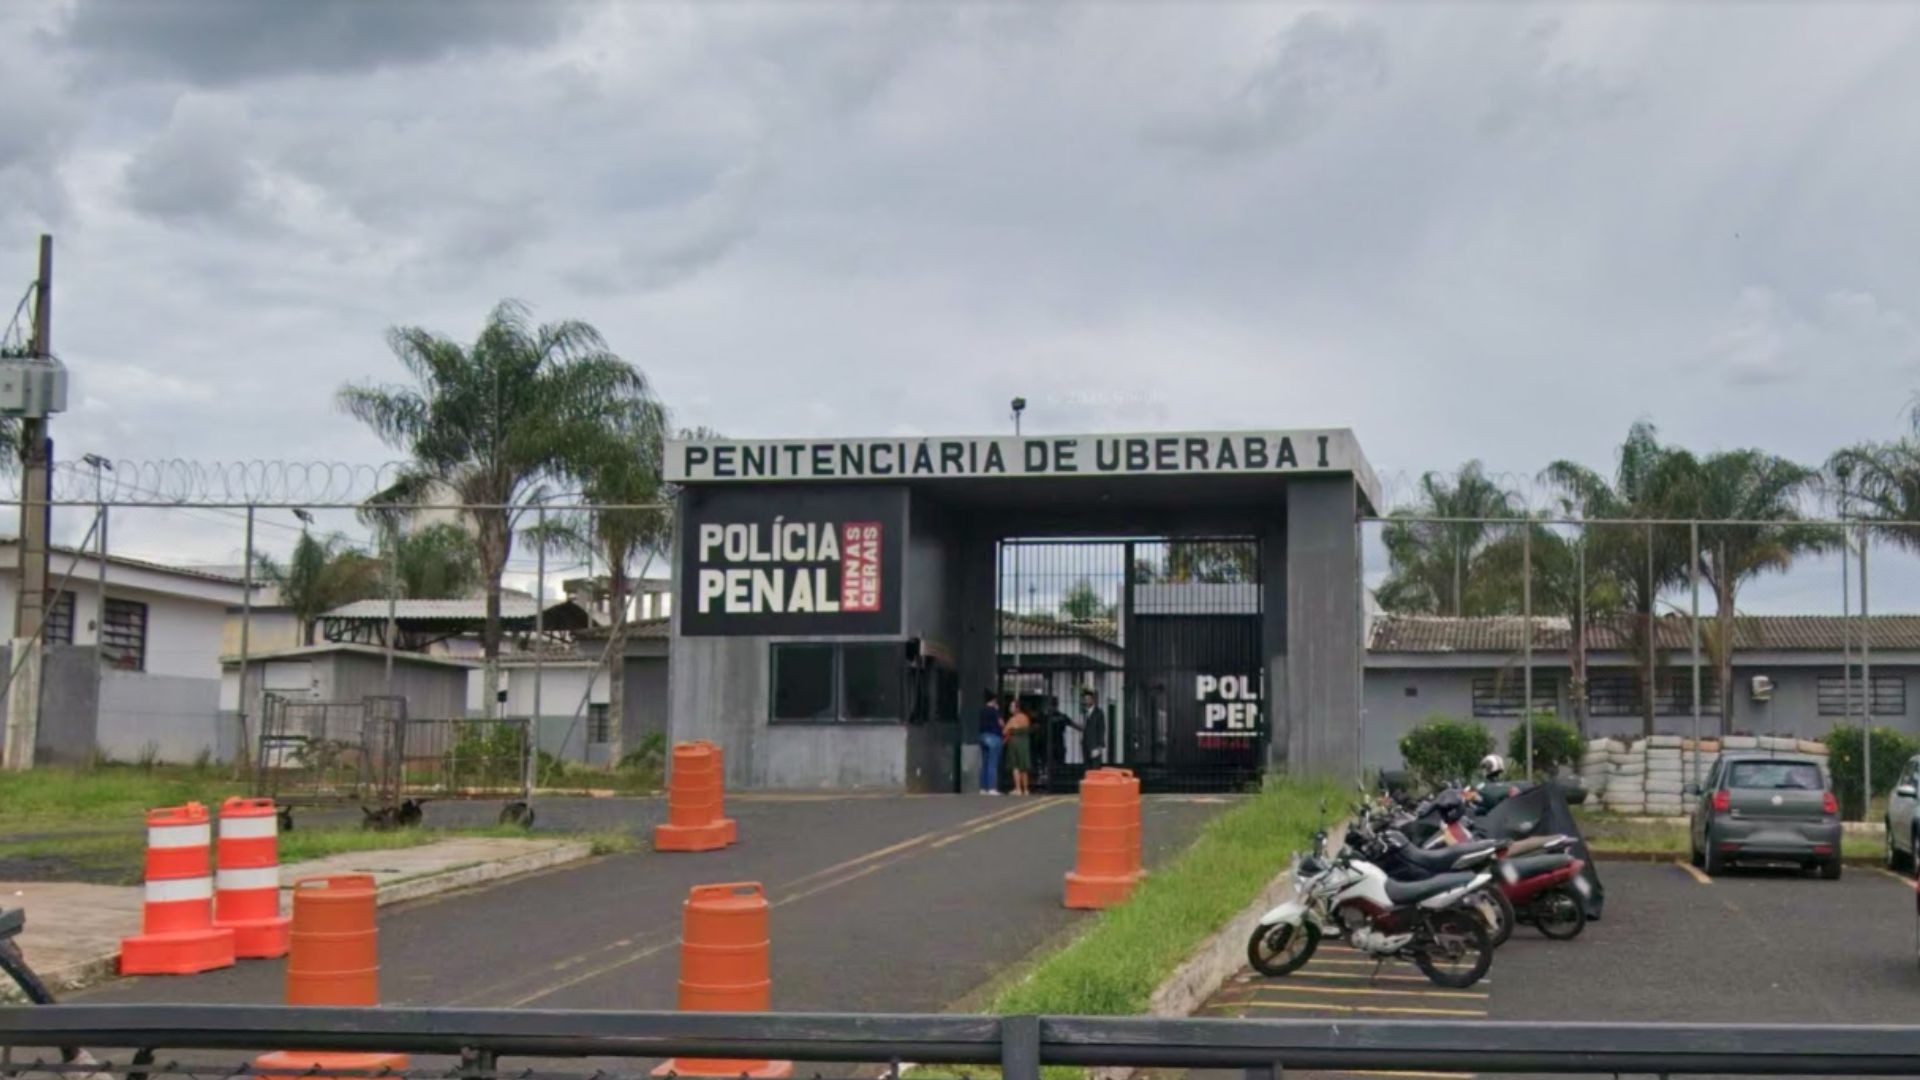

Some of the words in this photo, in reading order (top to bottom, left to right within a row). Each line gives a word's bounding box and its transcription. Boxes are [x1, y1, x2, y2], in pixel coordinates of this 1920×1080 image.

[684, 438, 1006, 478] PENITENCIÁRIA
[1024, 440, 1078, 472] DE
[1096, 436, 1299, 471] UBERABA
[1317, 436, 1329, 467] I
[699, 515, 840, 562] POLÍCIA
[844, 526, 860, 608] MINAS
[862, 526, 878, 606] GERAIS
[698, 568, 840, 613] PENAL
